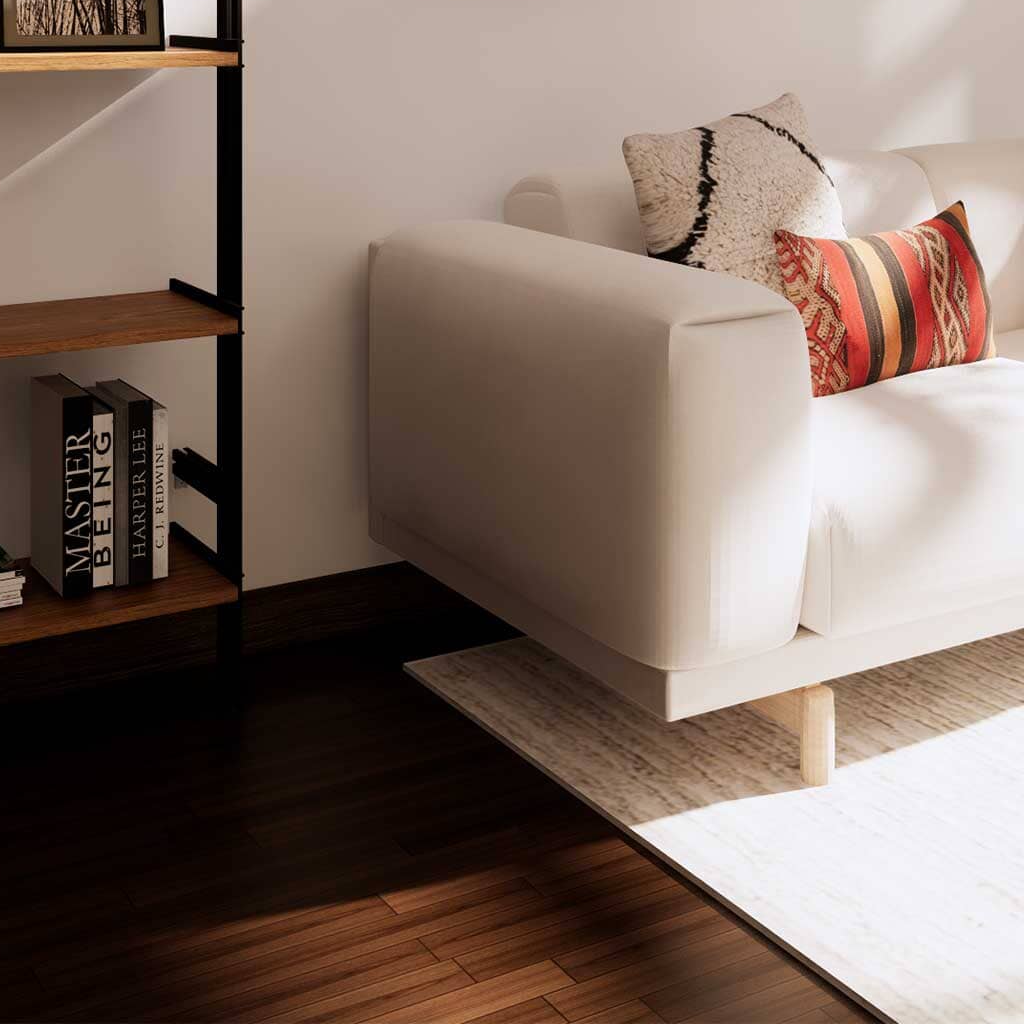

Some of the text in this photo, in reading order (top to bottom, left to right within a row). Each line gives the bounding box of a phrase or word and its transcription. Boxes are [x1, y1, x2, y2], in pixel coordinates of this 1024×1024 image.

[64, 428, 91, 576] MASTER
[93, 431, 112, 568] BEING
[133, 428, 146, 558] HARPER LEE
[155, 443, 164, 514] REDWINE
[155, 536, 164, 548] C.
